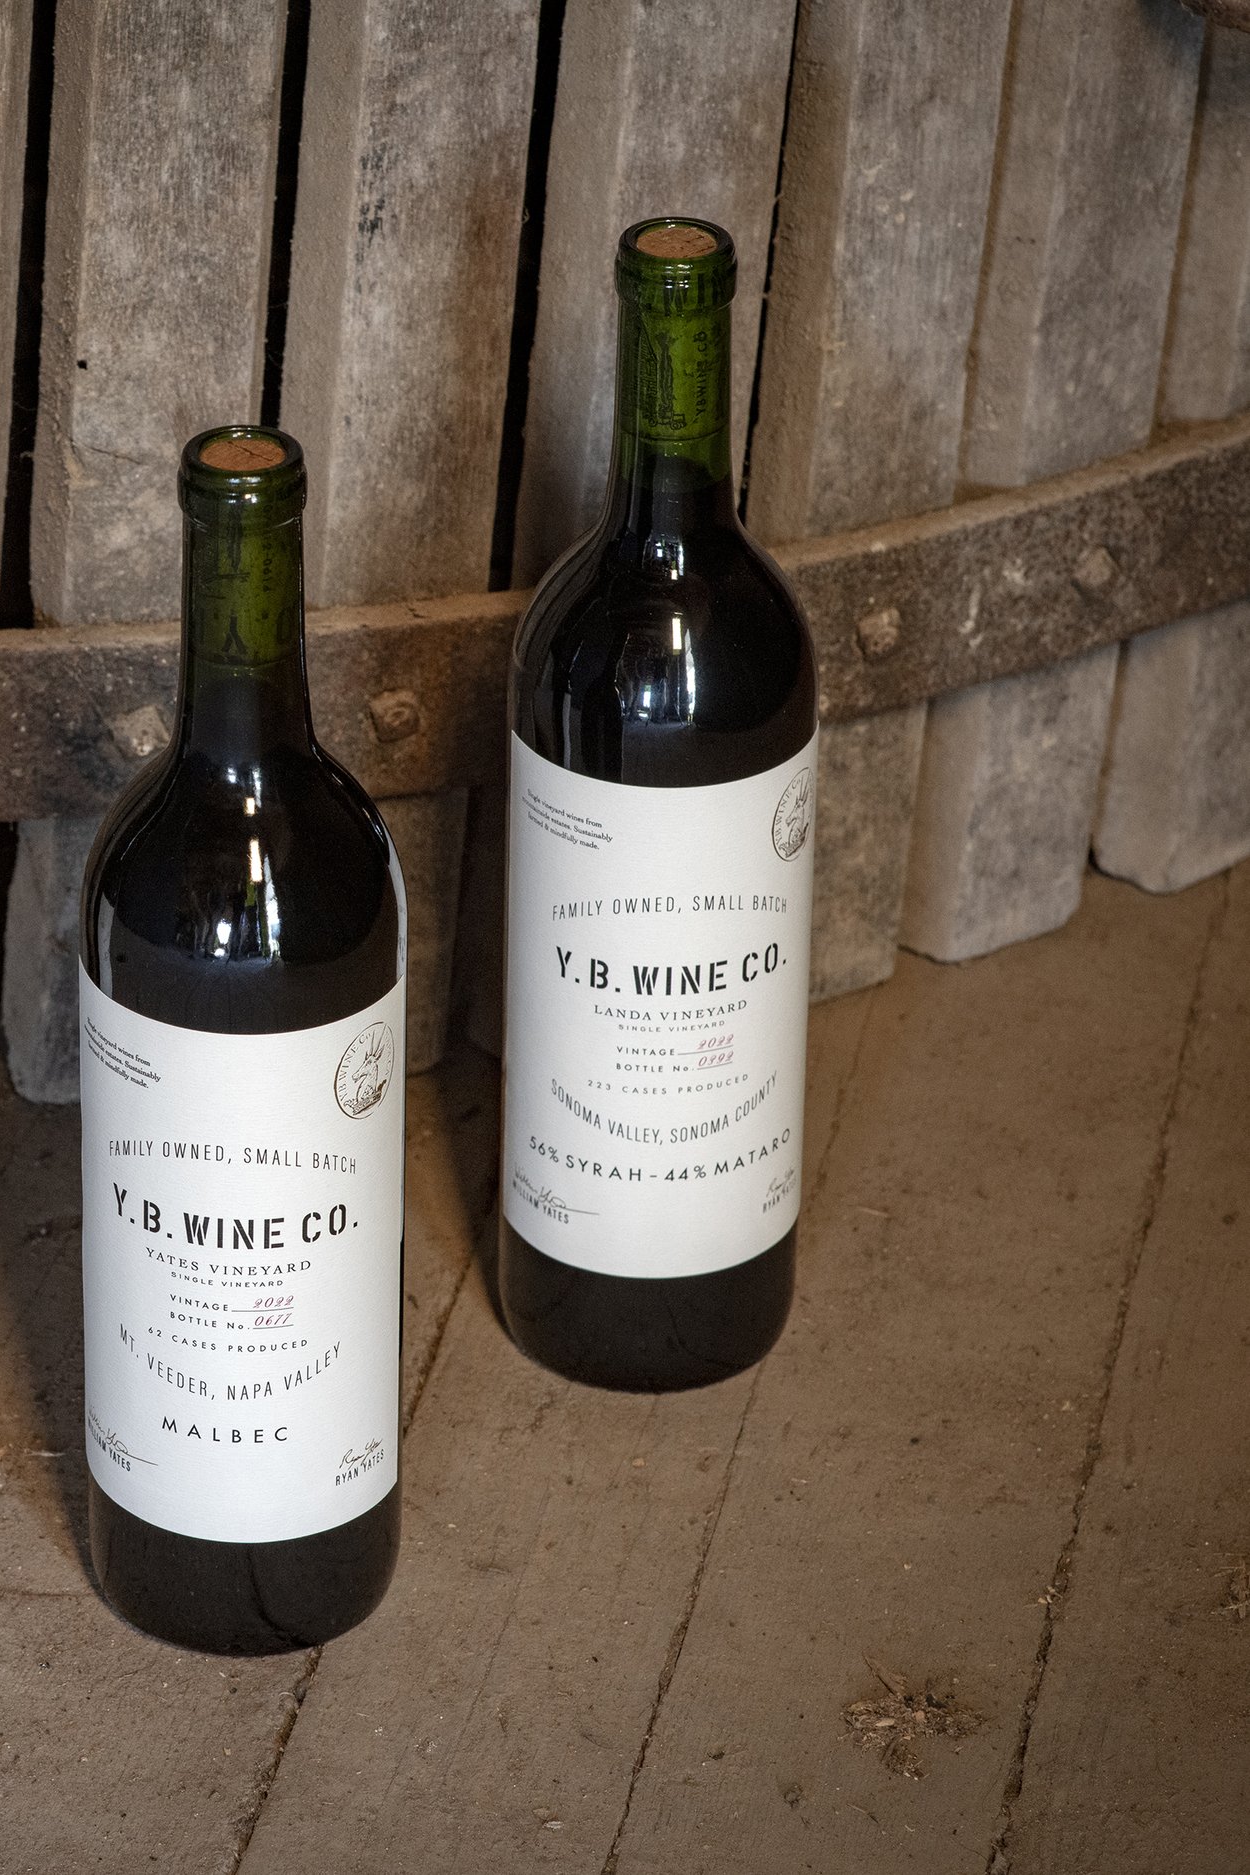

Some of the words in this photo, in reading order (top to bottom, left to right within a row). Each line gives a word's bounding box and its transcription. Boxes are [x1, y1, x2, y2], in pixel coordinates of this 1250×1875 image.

[542, 801, 565, 816] vineyard
[566, 812, 584, 823] wines
[586, 818, 602, 828] from
[550, 828, 578, 844] mindfully
[580, 840, 599, 850] made.
[551, 817, 572, 830] estates.
[573, 825, 613, 842] Sustainably
[552, 900, 603, 921] FAMILY
[613, 896, 681, 915] OWNED,
[692, 895, 743, 911] SMALL
[753, 895, 787, 913] BATCH
[633, 960, 728, 996] WINE
[742, 943, 786, 982] CO.
[594, 1004, 651, 1021] LANDA
[660, 1000, 747, 1020] VINEYARD
[619, 1024, 659, 1032] SINGLE
[669, 1020, 725, 1032] VINEYARD
[98, 1032, 117, 1049] vineyard
[118, 1047, 134, 1059] wines
[135, 1055, 150, 1066] from
[616, 1047, 676, 1056] VINTAGE
[696, 1033, 734, 1050] 2022
[105, 1061, 130, 1080] mindfully
[131, 1076, 148, 1088] made.
[125, 1061, 161, 1082] Sustainably
[616, 1063, 663, 1072] BOTTLE
[588, 1079, 611, 1091] 223
[622, 1086, 667, 1095] CASES
[678, 1074, 748, 1093] PRODUCED
[551, 1078, 602, 1129] SONOMA
[608, 1119, 663, 1146] VALLEY,
[670, 1114, 729, 1143] SONOMA
[735, 1070, 777, 1122] COUNTY
[109, 1140, 153, 1156] FAMILY
[163, 1141, 231, 1164] OWNED,
[243, 1147, 301, 1167] SMALL
[313, 1152, 356, 1174] BATCH
[529, 1135, 559, 1163] 56%
[714, 1128, 791, 1175] MATARO
[513, 1180, 539, 1209] WILLIAM
[543, 1204, 569, 1224] YATES
[183, 1212, 285, 1250] WINE
[302, 1204, 358, 1243] CO.
[146, 1247, 199, 1271] YATES
[209, 1260, 311, 1276] VINEYARD
[171, 1271, 213, 1286] SINGLE
[221, 1280, 283, 1288] VINEYARD
[170, 1294, 229, 1311] VINTAGE
[253, 1295, 294, 1309] 2022
[170, 1311, 218, 1328] BOTTLE
[227, 1321, 250, 1330] No.
[254, 1313, 292, 1326] 0677
[148, 1327, 162, 1337] 62
[171, 1335, 216, 1351] CASES
[228, 1339, 307, 1353] PRODUCED
[120, 1323, 139, 1358] MT.
[147, 1353, 215, 1400] VEEDER,
[227, 1381, 272, 1400] NAPA
[281, 1339, 340, 1390] VALLEY
[162, 1416, 287, 1443] MALBEC
[109, 1449, 130, 1472] YATES
[335, 1468, 359, 1486] RYAN
[363, 1449, 384, 1472] YATES
